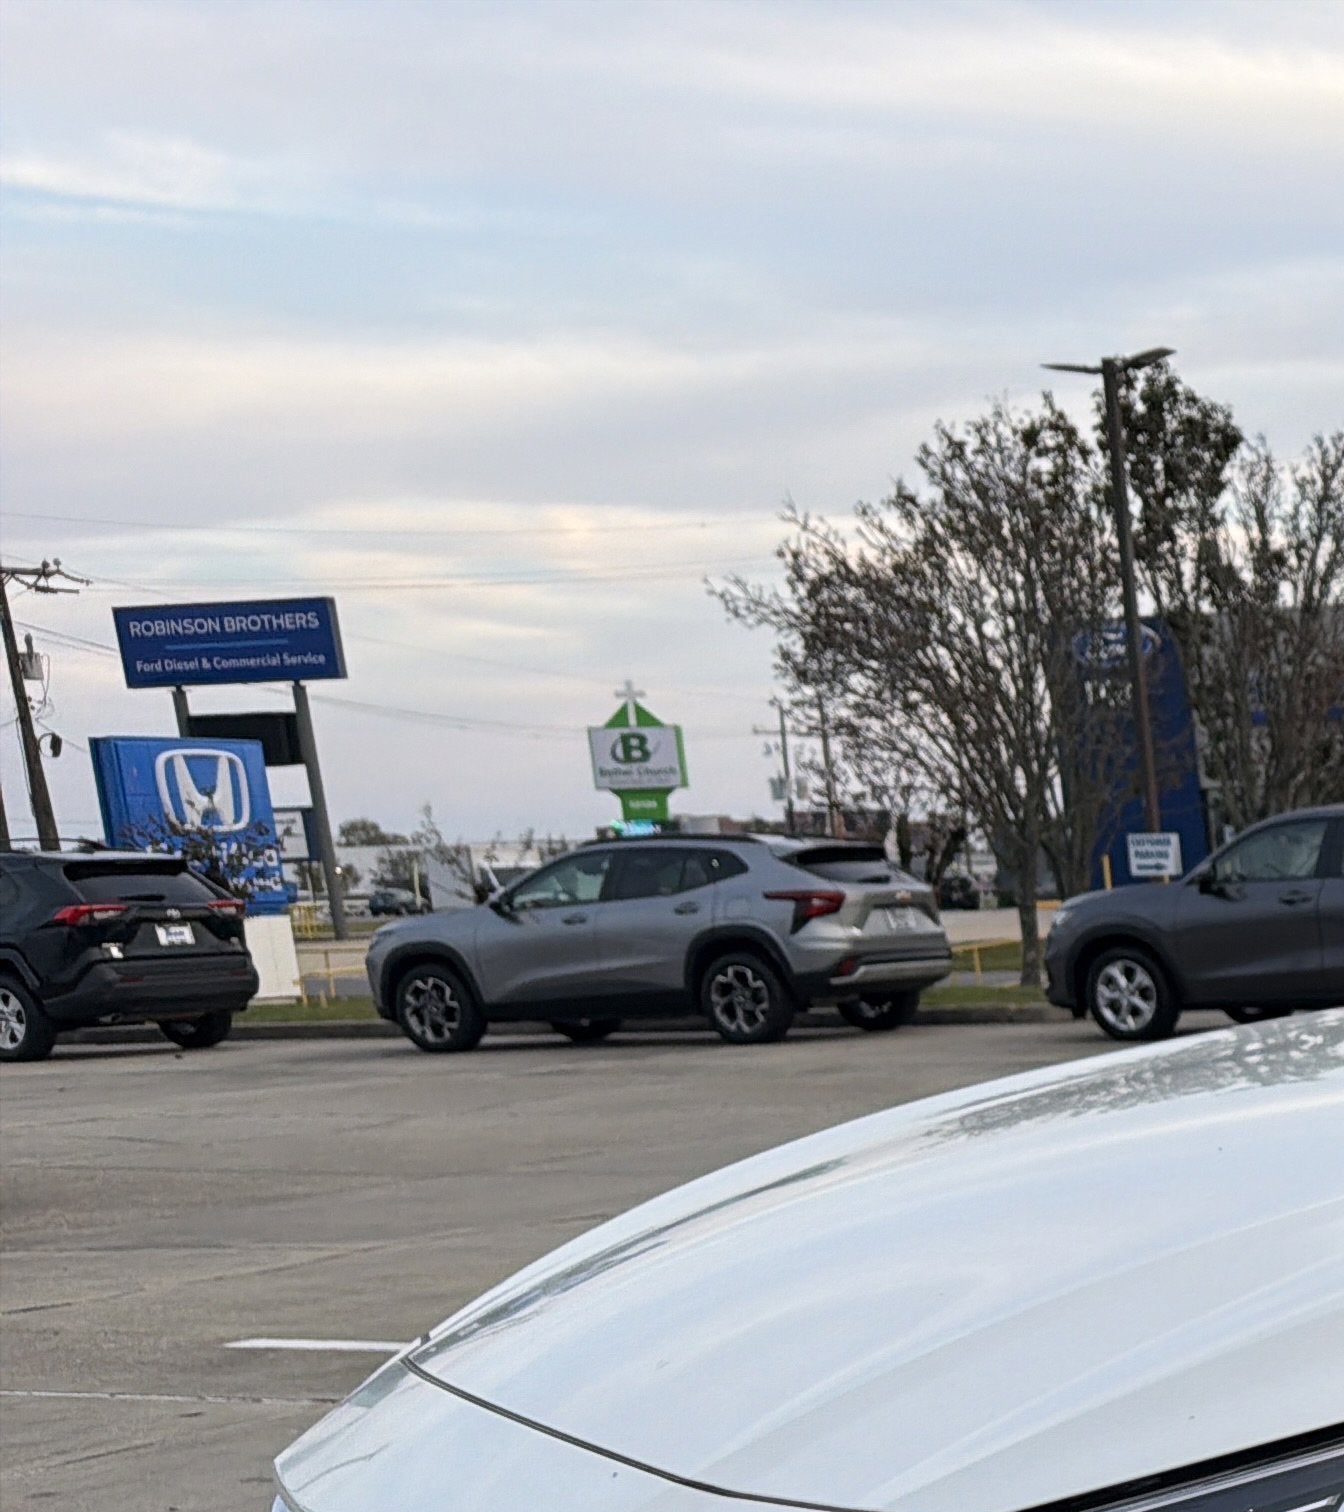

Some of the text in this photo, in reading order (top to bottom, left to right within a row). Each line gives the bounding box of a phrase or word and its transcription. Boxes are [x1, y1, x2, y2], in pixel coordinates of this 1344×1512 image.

[129, 611, 320, 638] ROBINSON BROTHERS
[136, 651, 326, 673] Ford Diesel & Commercial Service
